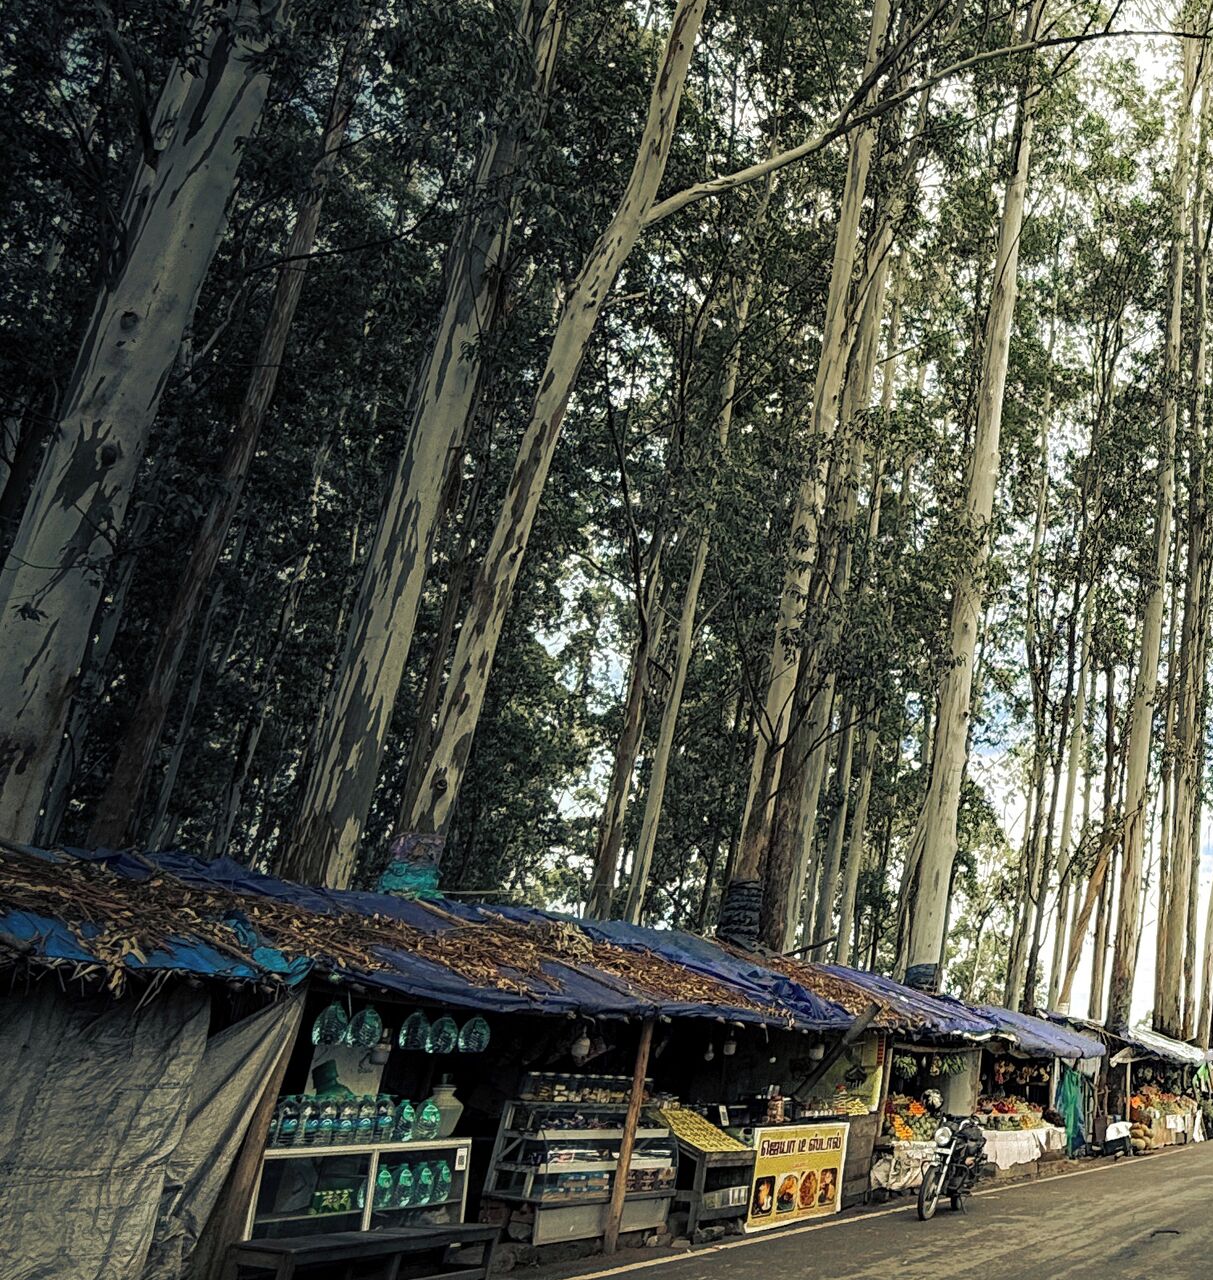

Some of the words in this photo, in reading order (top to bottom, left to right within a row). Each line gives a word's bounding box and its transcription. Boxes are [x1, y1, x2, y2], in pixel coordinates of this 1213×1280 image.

[760, 1138, 796, 1157] ஜெயா
[798, 1137, 807, 1153] டீ
[808, 1132, 842, 1151] ஸ்டால்
